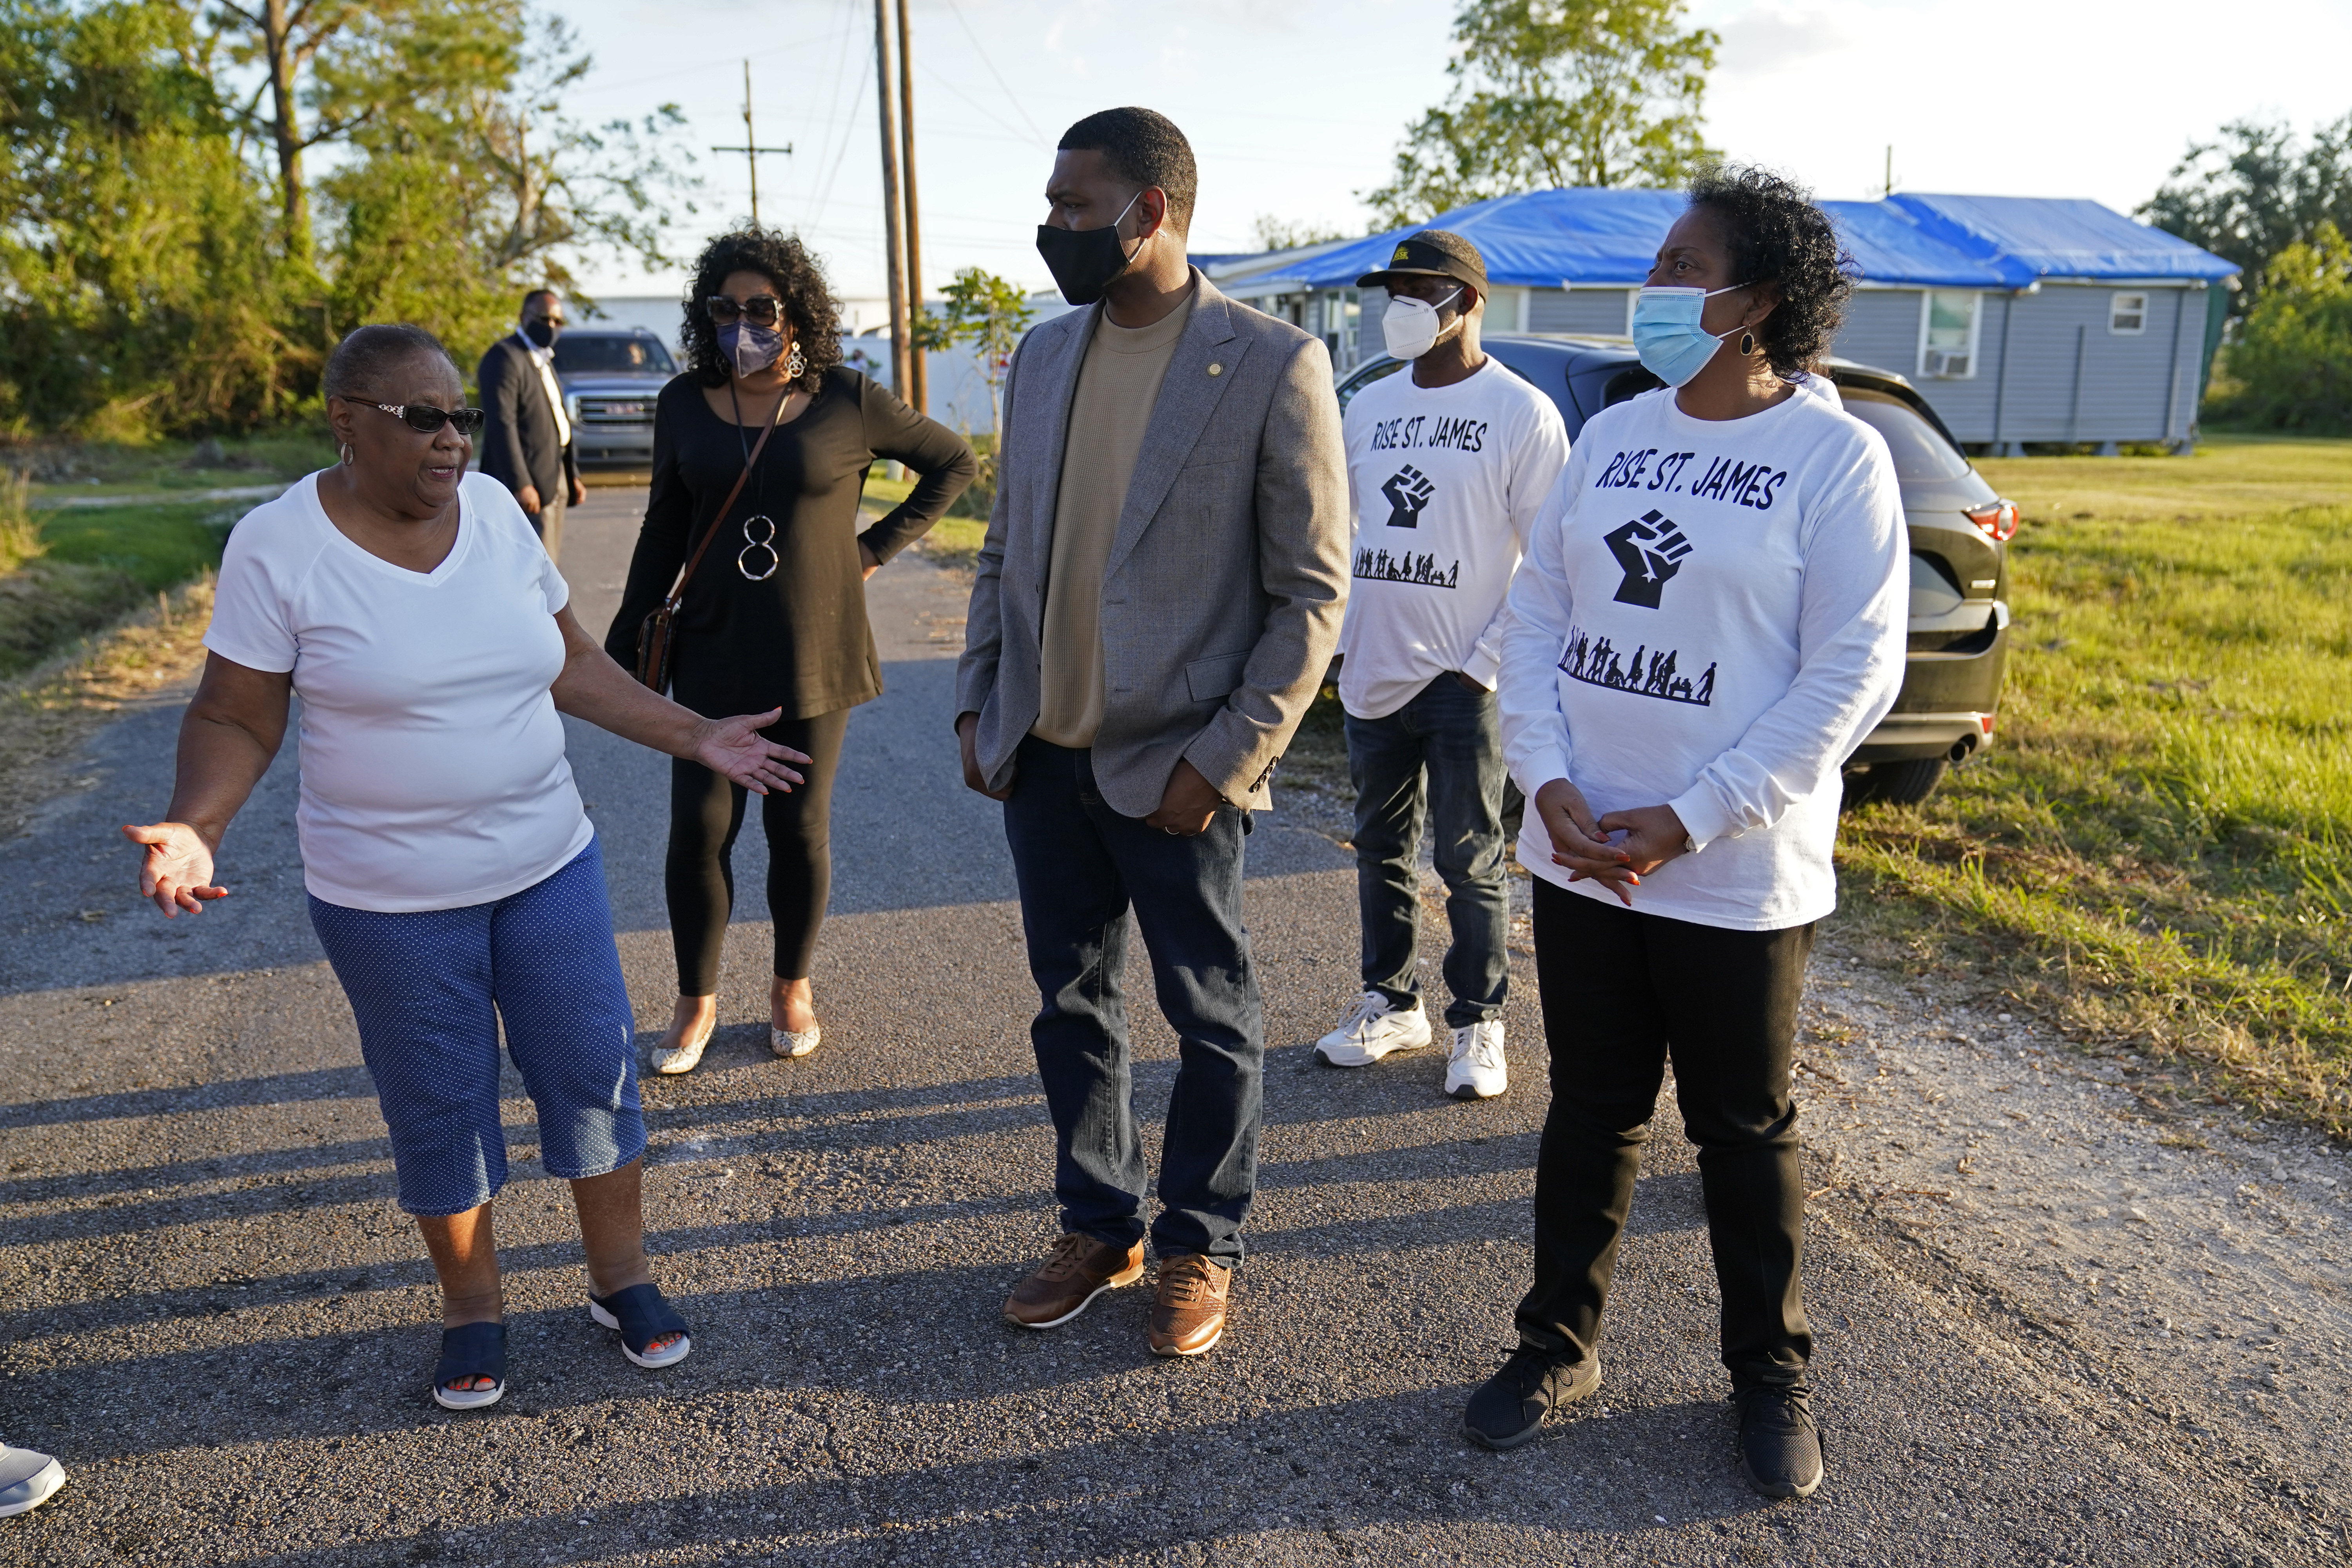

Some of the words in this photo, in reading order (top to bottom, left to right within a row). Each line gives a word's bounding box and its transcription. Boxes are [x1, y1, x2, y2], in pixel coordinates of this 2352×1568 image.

[1370, 417, 1402, 451] RISE
[1401, 416, 1426, 448] ST.
[1429, 416, 1487, 452] JAMES
[1595, 448, 1658, 488] RISE
[1647, 452, 1695, 492] ST.
[1691, 456, 1787, 510] JAMES
